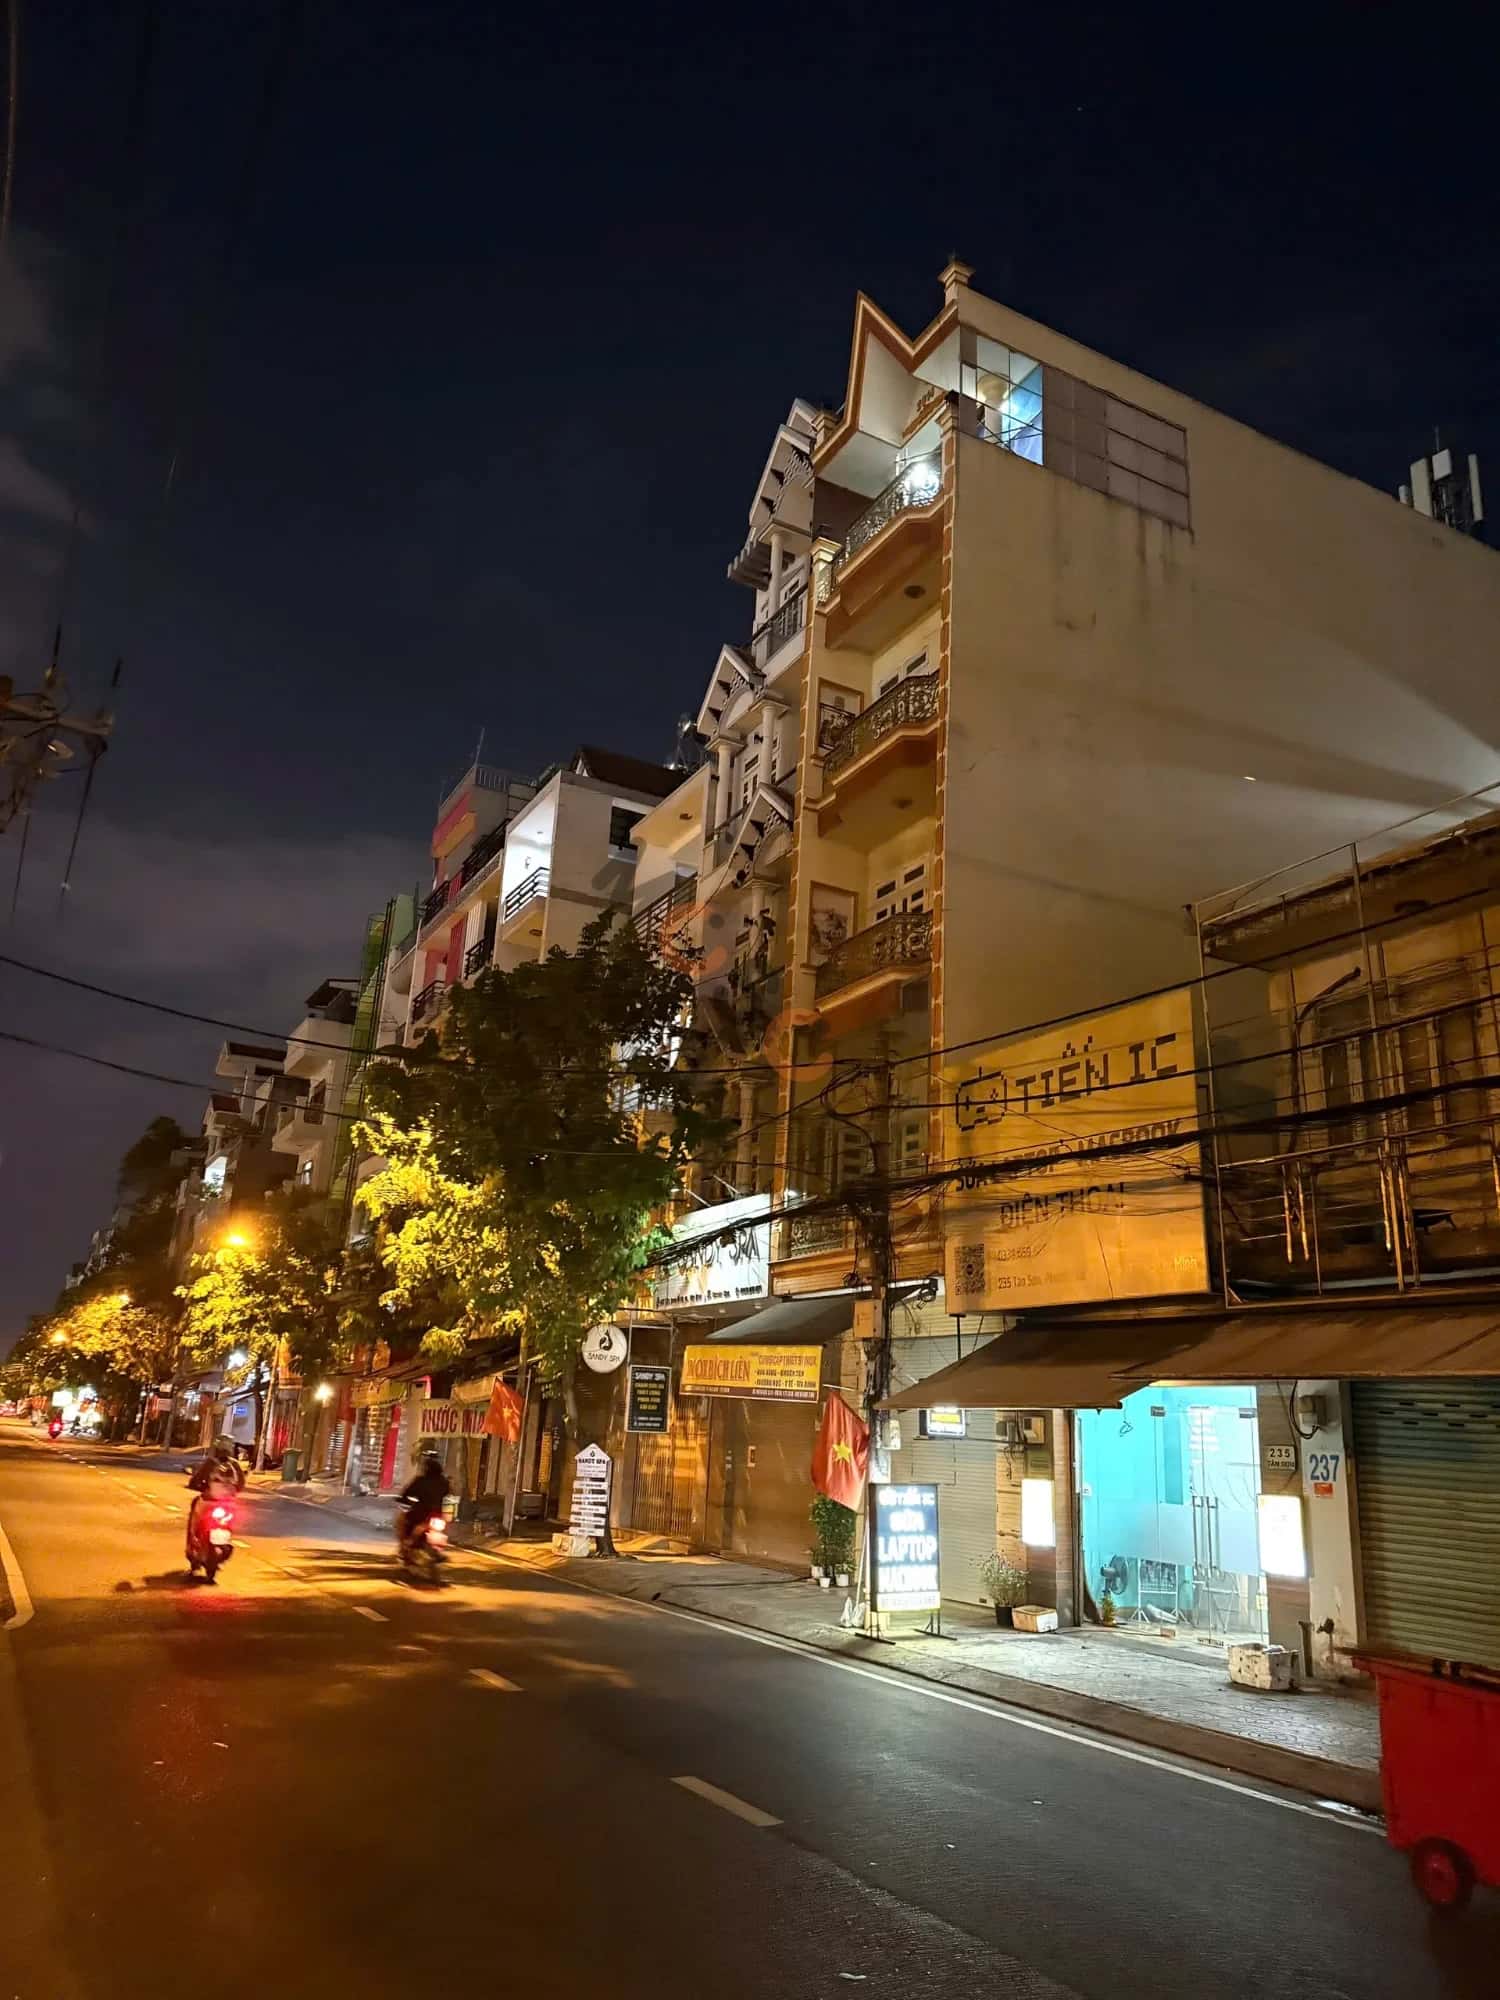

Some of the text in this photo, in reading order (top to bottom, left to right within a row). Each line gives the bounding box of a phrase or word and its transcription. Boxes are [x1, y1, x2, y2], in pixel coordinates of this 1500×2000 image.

[1015, 1033, 1178, 1113] TIẾN IC
[587, 1352, 621, 1364] SANDY SPA
[422, 1404, 458, 1433] NƯỚC
[1269, 1448, 1291, 1458] 235
[1309, 1454, 1340, 1482] 237
[878, 1535, 938, 1563] LAPTOP
